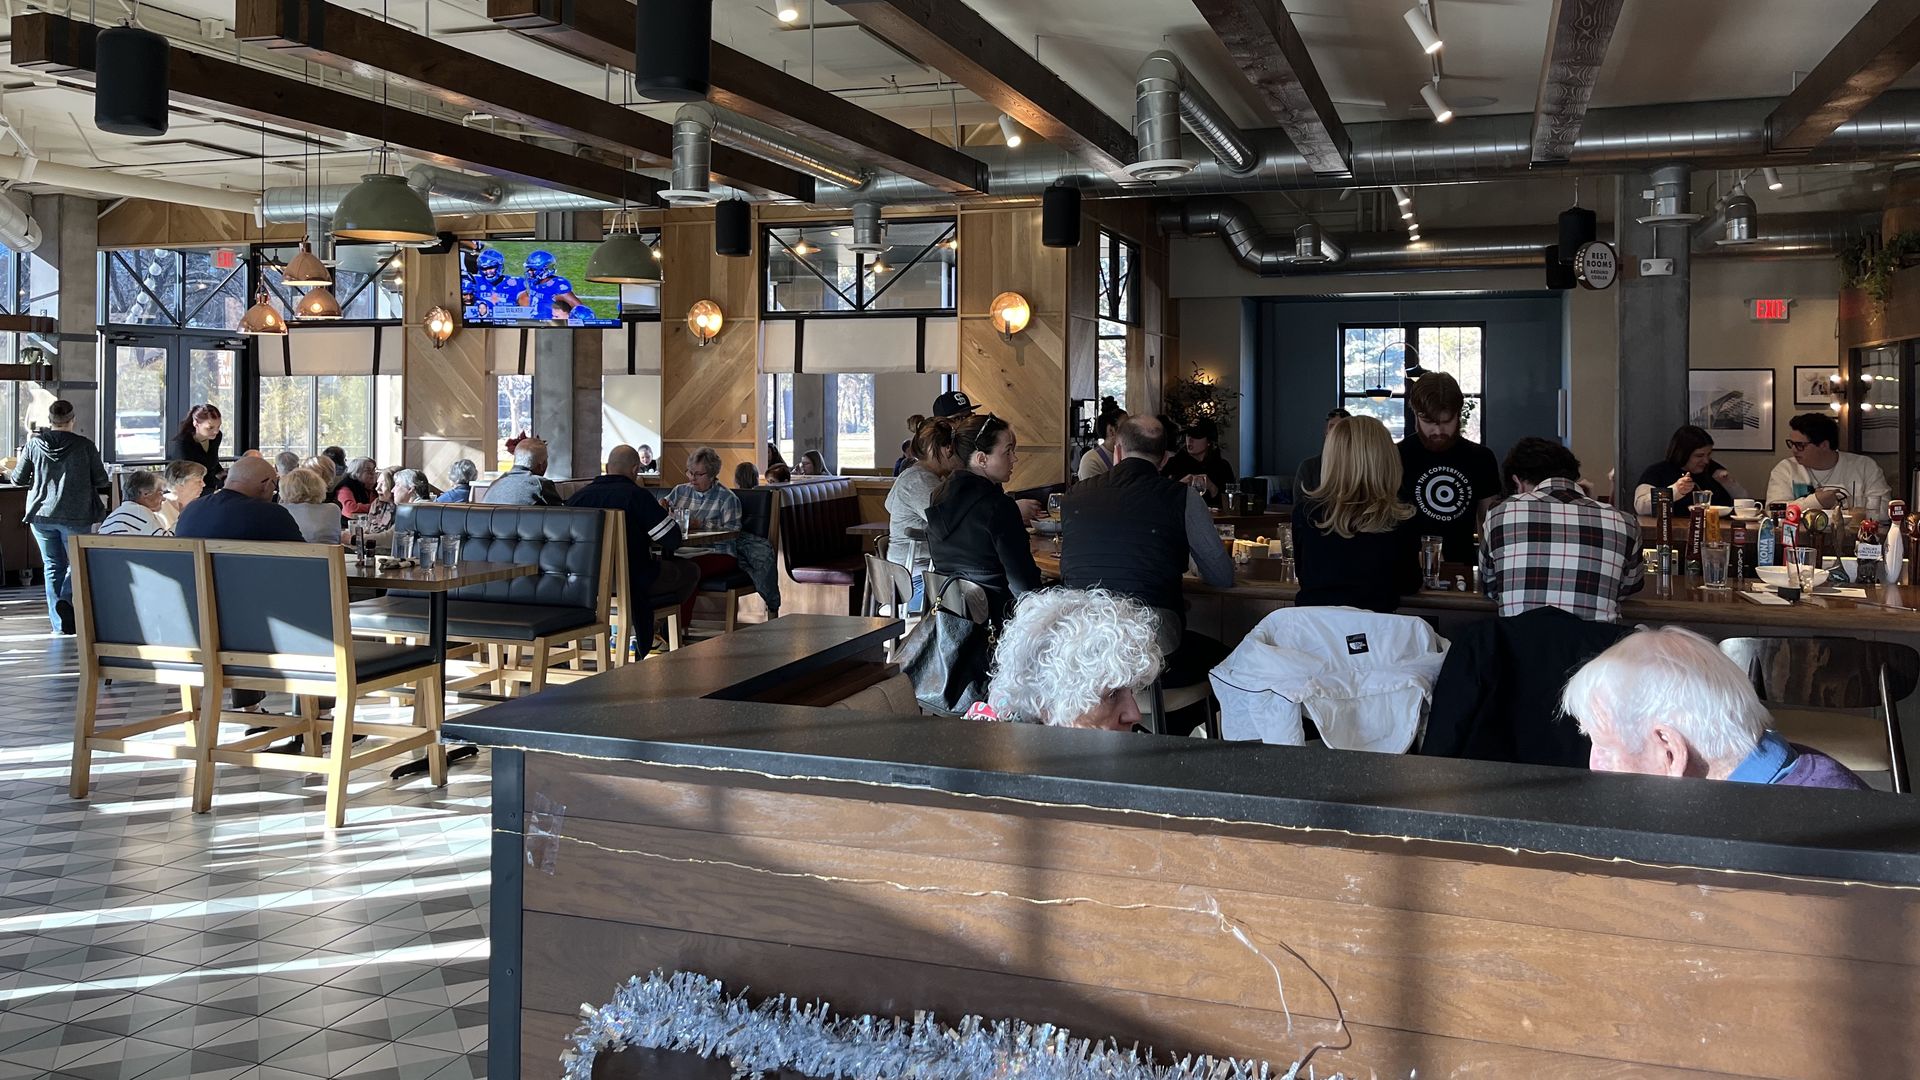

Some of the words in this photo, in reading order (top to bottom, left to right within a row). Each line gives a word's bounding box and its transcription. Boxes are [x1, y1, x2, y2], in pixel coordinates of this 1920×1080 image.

[1587, 260, 1612, 268] ROOMS
[1756, 299, 1783, 319] EXIT
[1417, 473, 1429, 484] THE
[1428, 466, 1469, 484] COPPERFIELD
[1760, 539, 1769, 563] KONA
